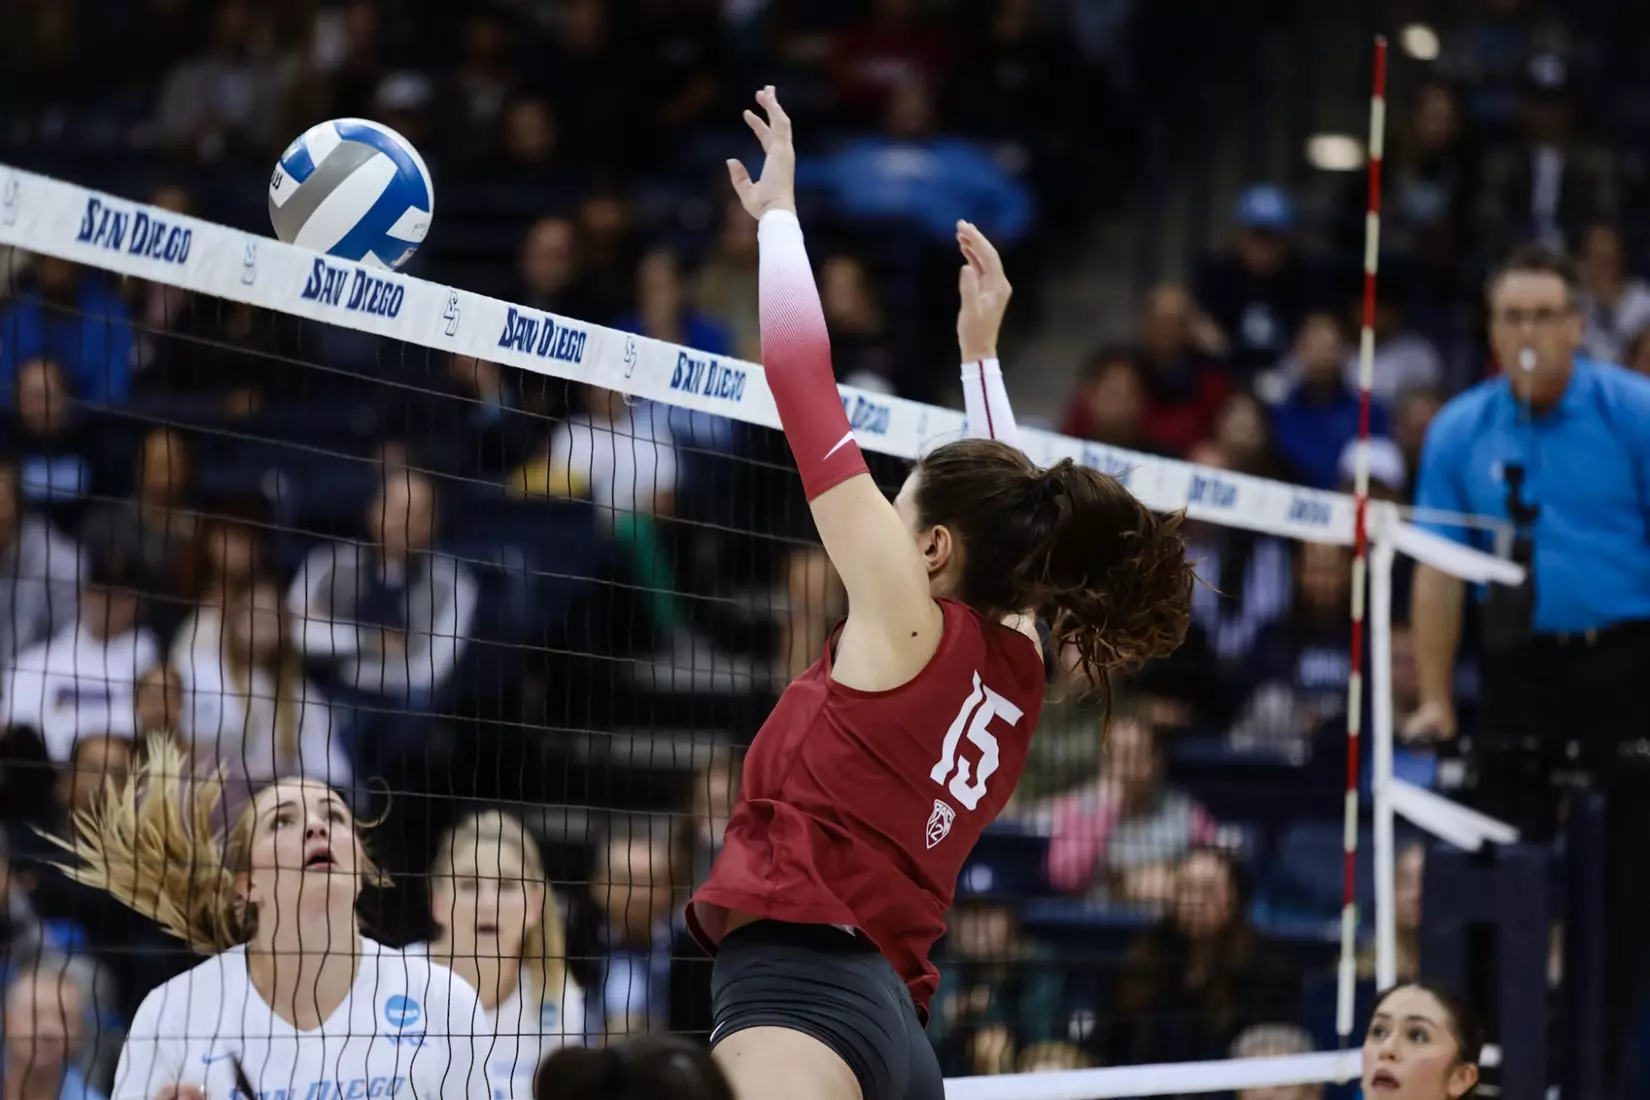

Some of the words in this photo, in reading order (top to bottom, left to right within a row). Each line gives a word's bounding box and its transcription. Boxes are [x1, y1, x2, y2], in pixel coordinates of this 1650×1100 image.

[77, 197, 130, 249] SAN
[127, 210, 193, 265] DIEGO
[302, 258, 348, 310] SAN
[345, 269, 405, 319] DIEGO
[498, 307, 540, 352] SAN
[536, 316, 588, 364] DIEGO
[669, 351, 706, 393] SAN
[703, 359, 747, 401] DIEGO
[930, 669, 1024, 811] 15
[928, 821, 944, 841] 12
